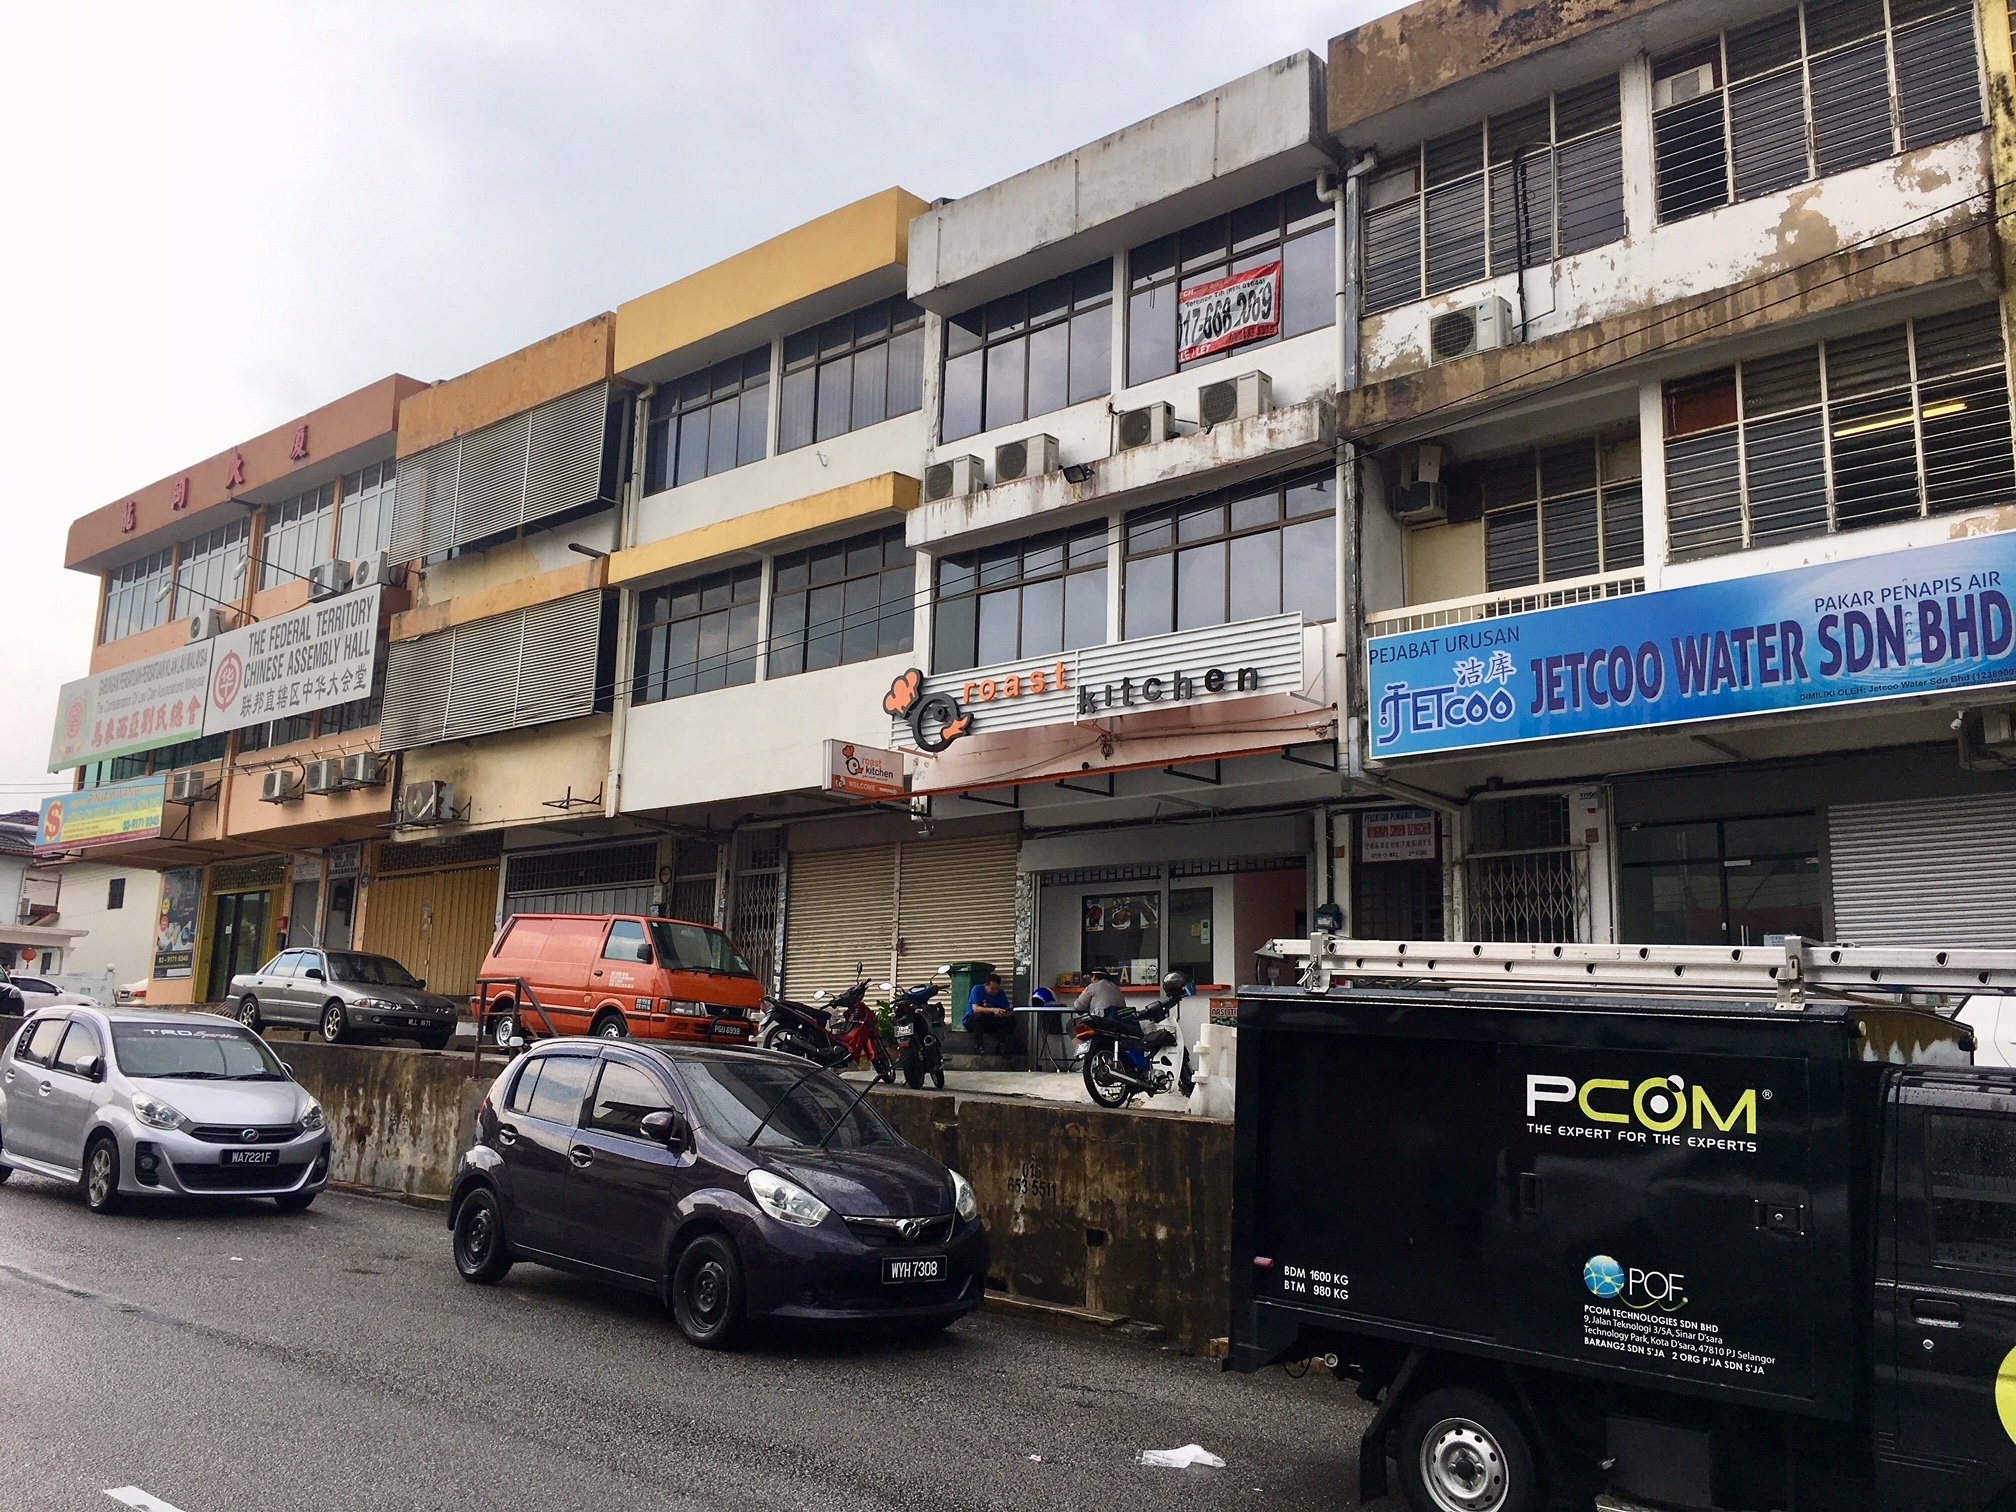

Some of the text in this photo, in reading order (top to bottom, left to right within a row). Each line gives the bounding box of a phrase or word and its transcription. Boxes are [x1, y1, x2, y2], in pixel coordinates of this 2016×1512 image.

[1196, 344, 1211, 356] LET
[1814, 571, 2001, 613] PAKAR PENAPIS AIR
[249, 595, 374, 658] THE FEDERAL TERRITORY
[244, 629, 370, 688] CHINESE ASSEMBLY HALL
[1370, 625, 1520, 665] PEJABAT URUSAN
[1531, 590, 2013, 716] JETCOO WATER SDN BHD
[240, 663, 367, 718] 联邦直辖区中华大会堂
[962, 661, 1069, 704] roast
[1079, 667, 1259, 715] kitchen
[1799, 690, 1835, 701] DIMILIKI
[1837, 686, 1866, 697] OLEH:
[1869, 682, 1899, 693] Jetcoo
[1900, 679, 1927, 689] Water
[1930, 676, 1949, 685] Sdn
[1951, 673, 1970, 683] Bhd
[862, 758, 882, 767] roast
[865, 766, 893, 778] kitchen
[849, 781, 876, 791] WELCOME
[714, 1025, 725, 1033] PGU
[1527, 1074, 1756, 1134] PCOM
[1527, 1123, 1757, 1152] THE EXPERT FOR THE EXPERTS
[231, 1151, 271, 1163] WA7221F
[891, 1261, 938, 1278] WYH 7308
[1284, 1266, 1349, 1285] BDM 1600 KG
[1284, 1280, 1349, 1300] BTM 980 KG
[1629, 1268, 1684, 1301] POF
[1584, 1305, 1718, 1333] PCOM TECHNOLOGIES SDN BHD
[1584, 1315, 1591, 1324] 9,
[1592, 1316, 1611, 1327] Jalan
[1613, 1319, 1651, 1334] Teknologi
[1675, 1330, 1695, 1340] Sinar
[1584, 1326, 1629, 1341] Technology
[1630, 1335, 1649, 1345] Park,
[1651, 1337, 1669, 1347] Kota
[1699, 1345, 1724, 1356] 47810
[1726, 1349, 1736, 1358] PJ
[1737, 1351, 1776, 1365] Selangor
[1584, 1337, 1765, 1375] BARANG2 SDN S'JA 2 ORG P'JA SDN S'JA
